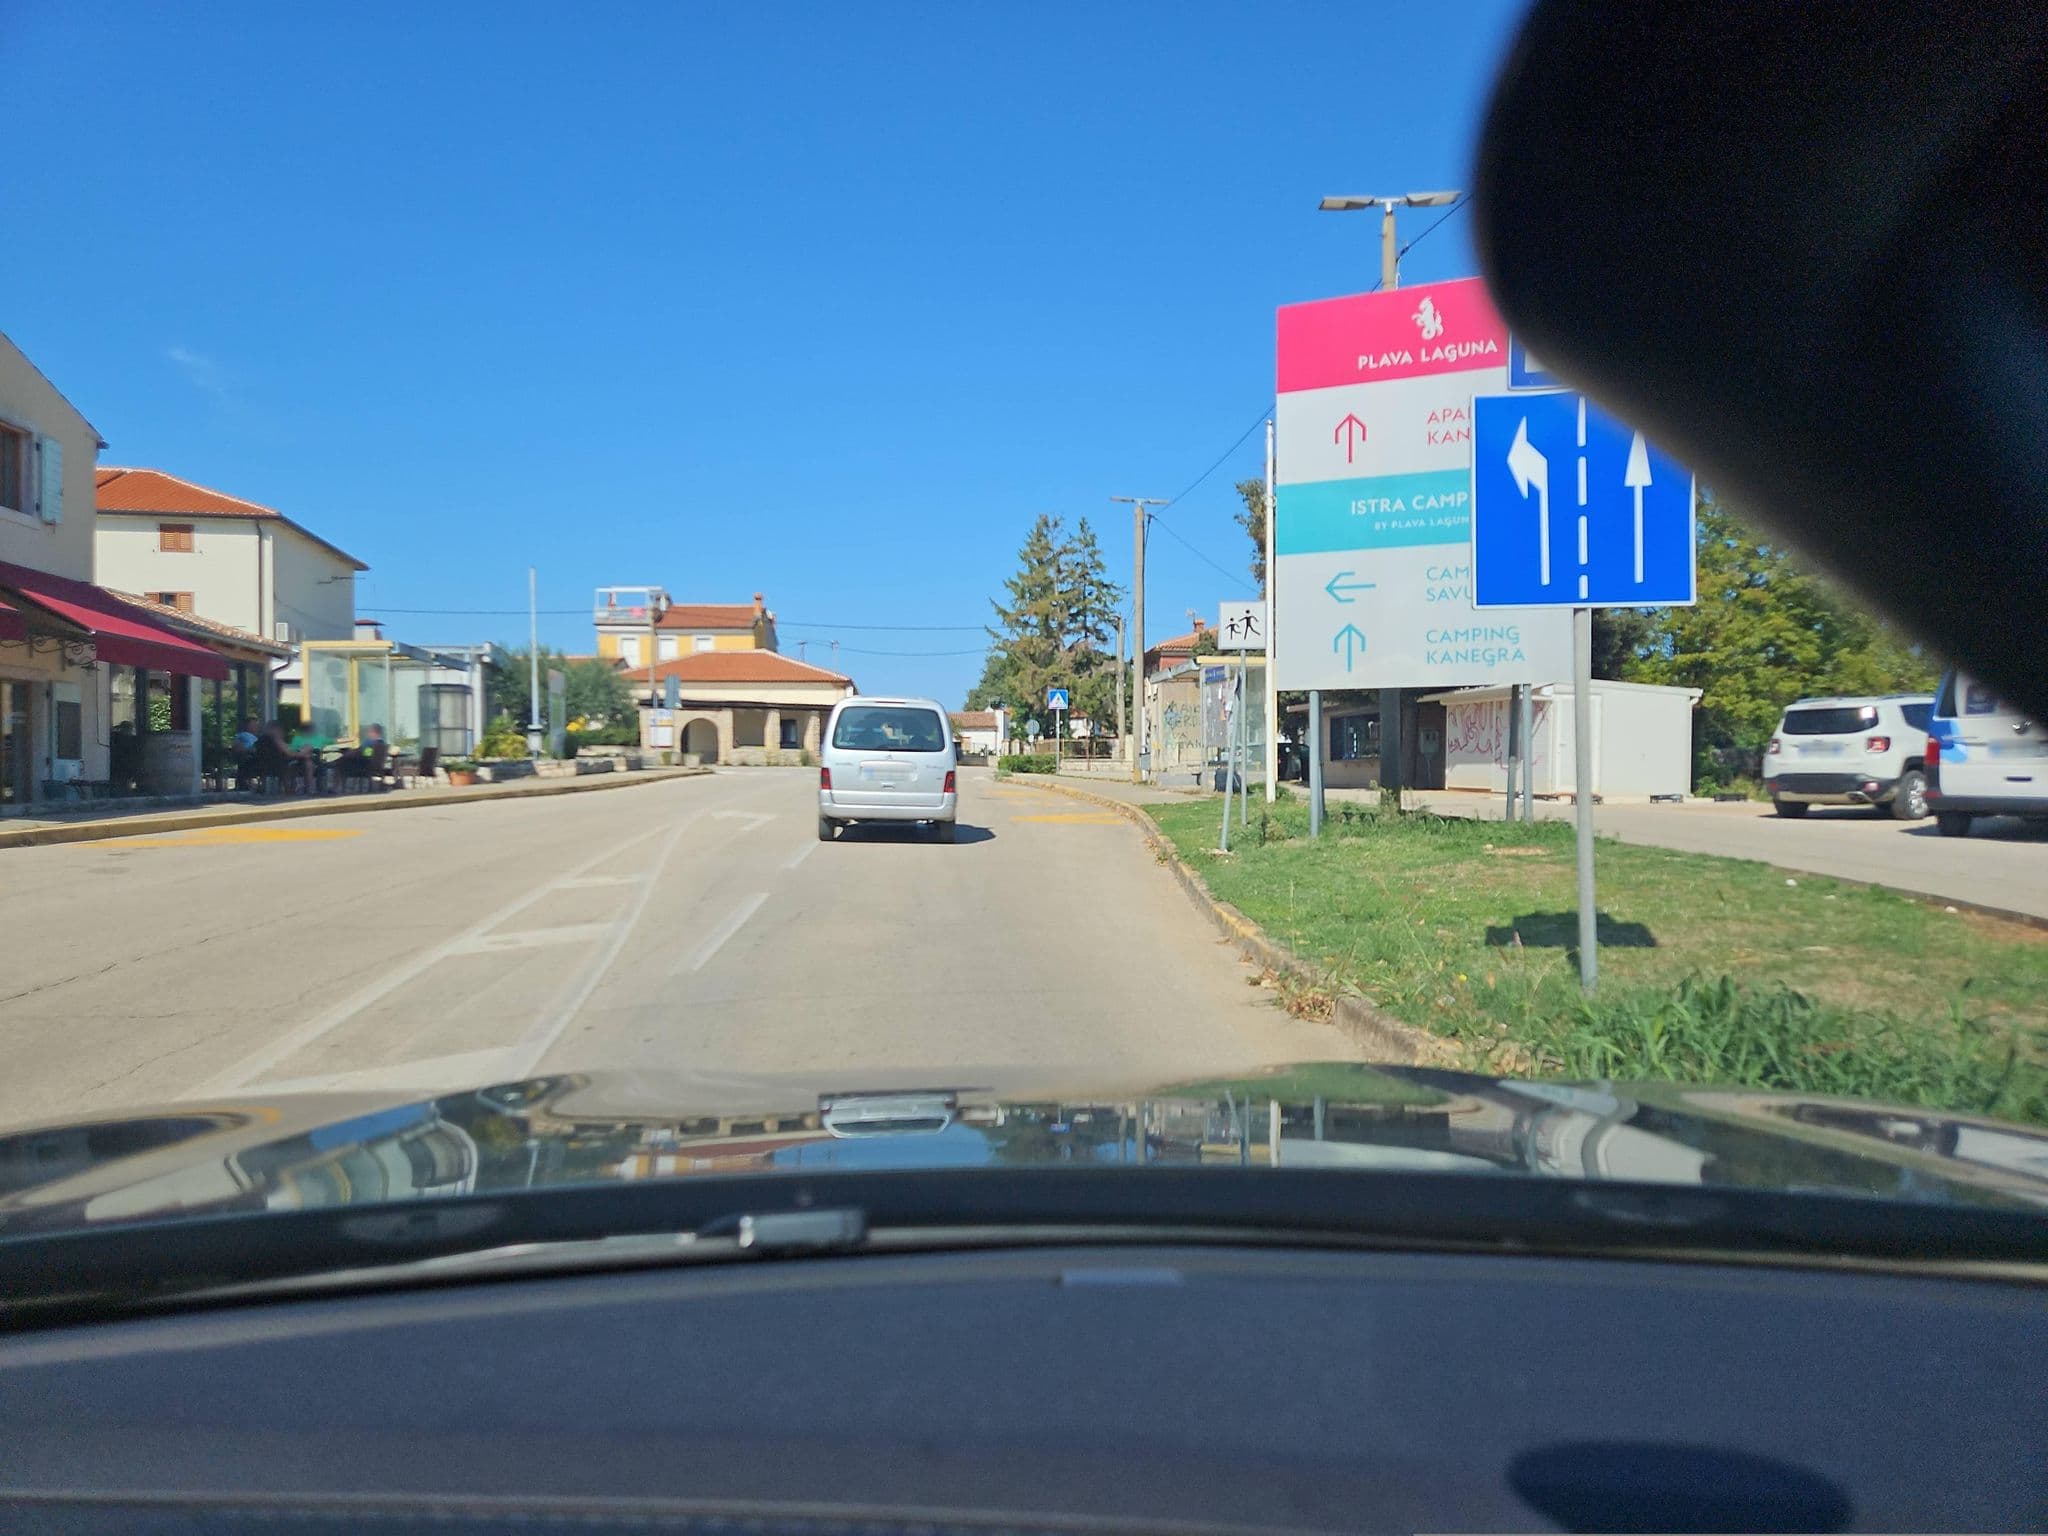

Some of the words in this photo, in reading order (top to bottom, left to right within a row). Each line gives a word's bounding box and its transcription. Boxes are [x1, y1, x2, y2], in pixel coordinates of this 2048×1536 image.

[1358, 350, 1414, 370] PLAVA
[1420, 339, 1498, 362] LAGUNA
[1427, 406, 1470, 424] APA
[1351, 498, 1406, 515] ISTRA
[1411, 491, 1468, 510] CAMP
[1374, 521, 1387, 531] BY
[1391, 518, 1425, 529] PLAVA
[1426, 625, 1520, 645] CAMPING
[1426, 647, 1526, 667] KANEGRA
